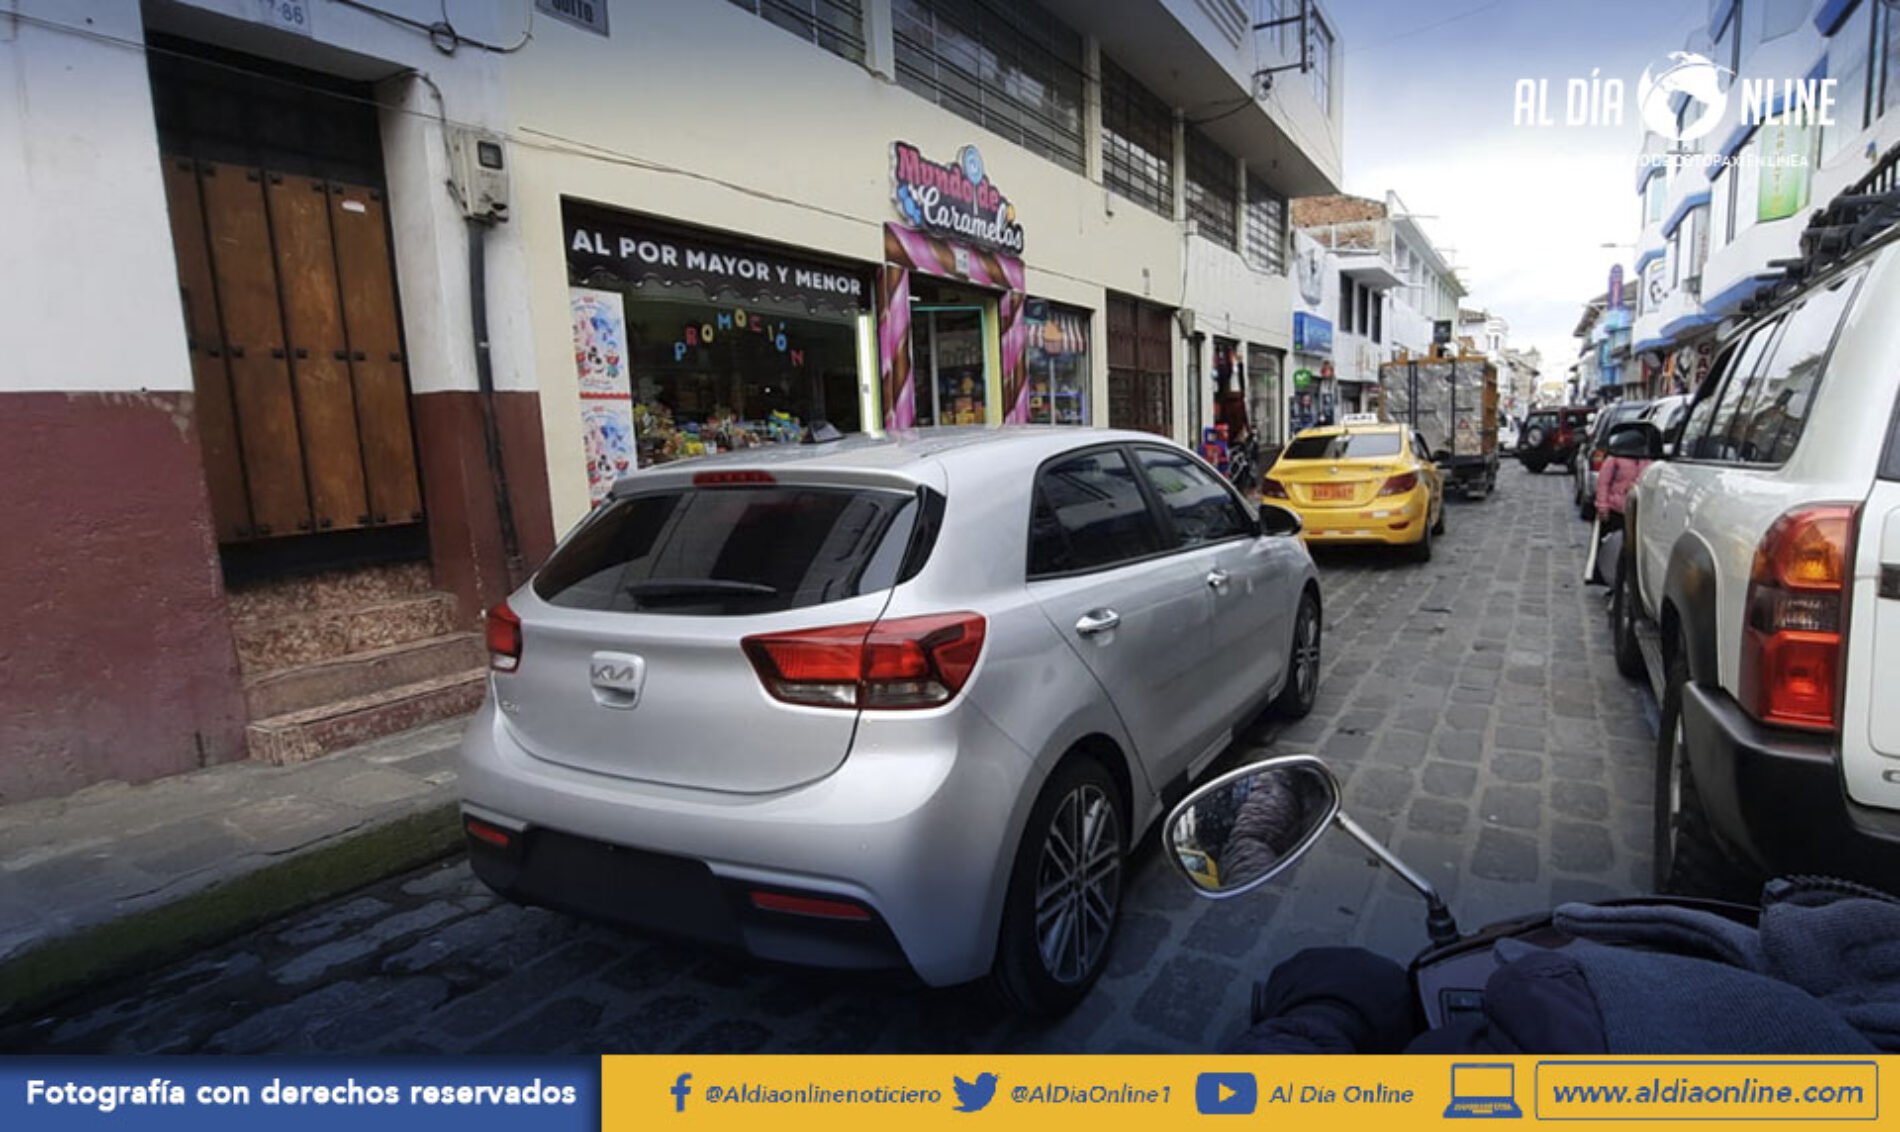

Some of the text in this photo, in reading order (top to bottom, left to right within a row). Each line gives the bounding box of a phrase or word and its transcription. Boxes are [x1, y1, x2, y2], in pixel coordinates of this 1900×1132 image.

[898, 145, 999, 213] Mundo de
[918, 184, 1022, 250] Caramelos
[571, 229, 862, 295] AL POR MAYOR Y MENOR
[673, 307, 805, 367] PROMOCIÓN
